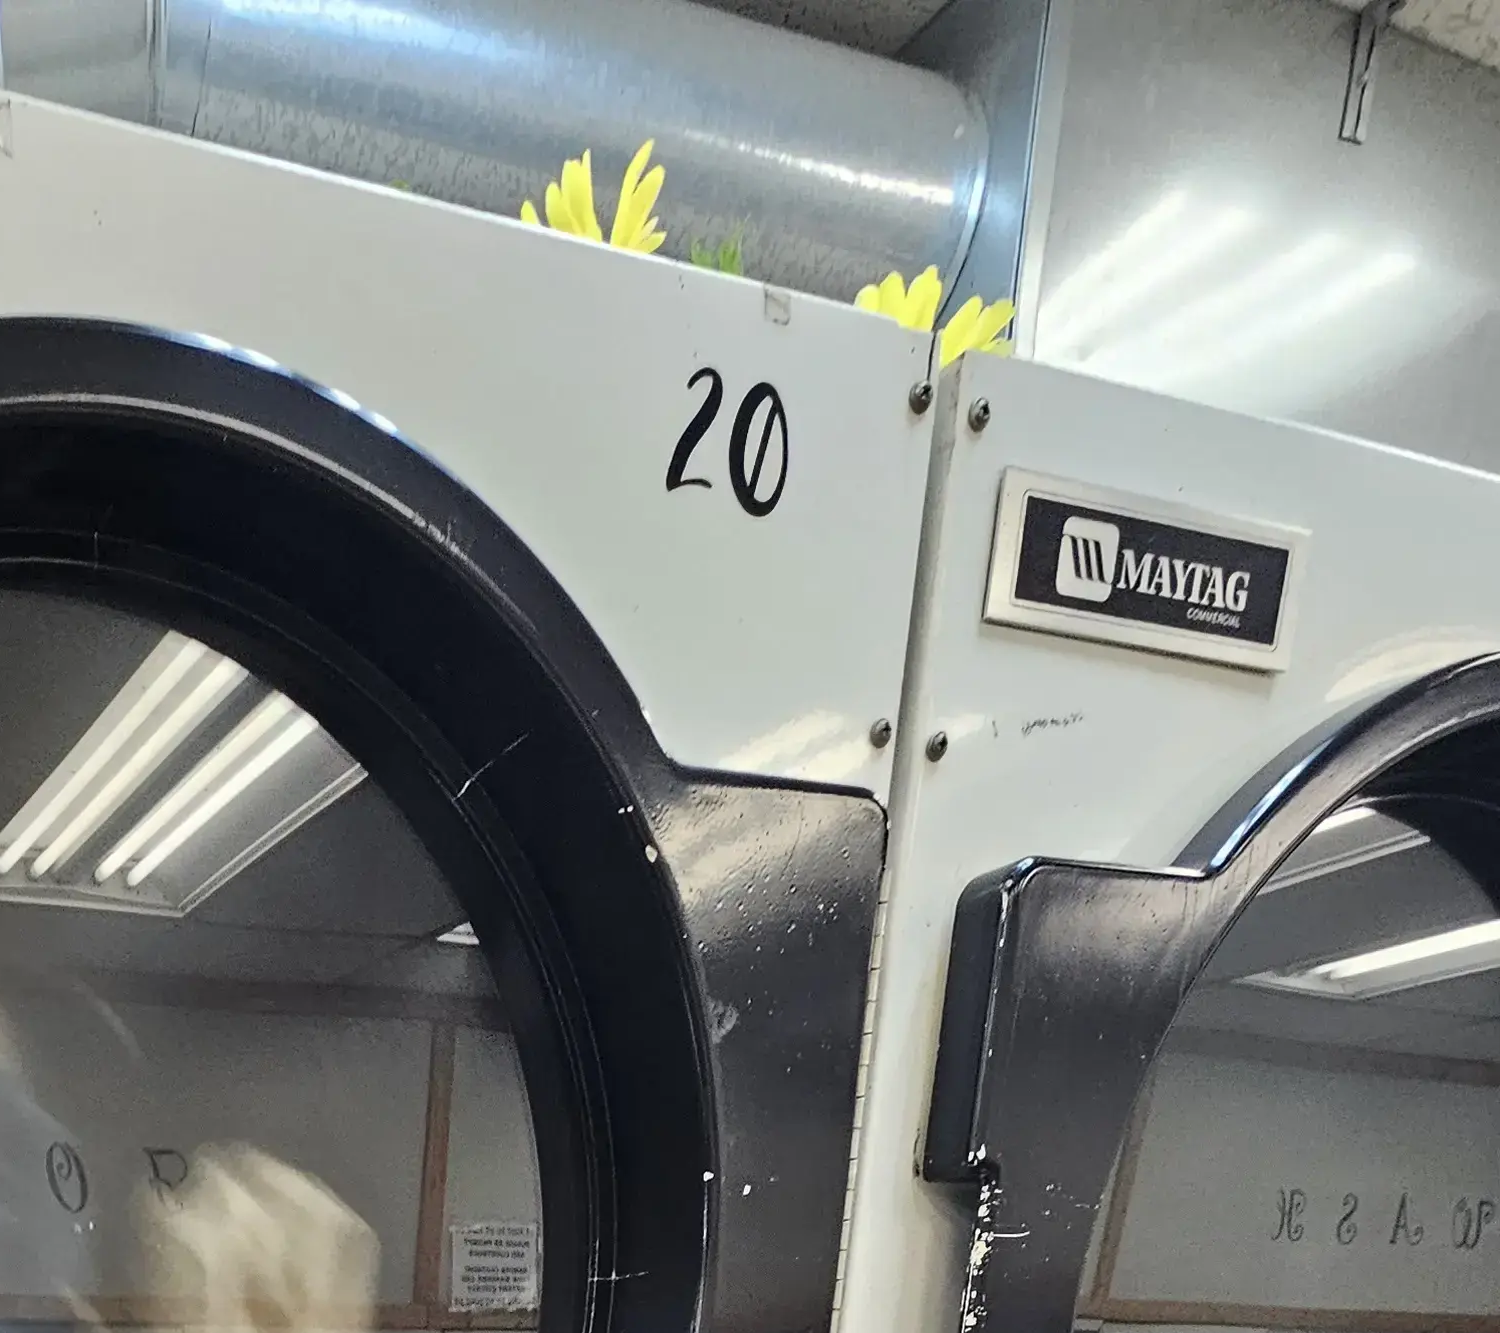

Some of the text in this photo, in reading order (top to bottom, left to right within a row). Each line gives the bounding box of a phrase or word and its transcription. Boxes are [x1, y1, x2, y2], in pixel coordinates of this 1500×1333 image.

[667, 367, 789, 516] 20
[1115, 550, 1250, 611] MAYTAG
[1187, 607, 1241, 629] COMMERCIAL
